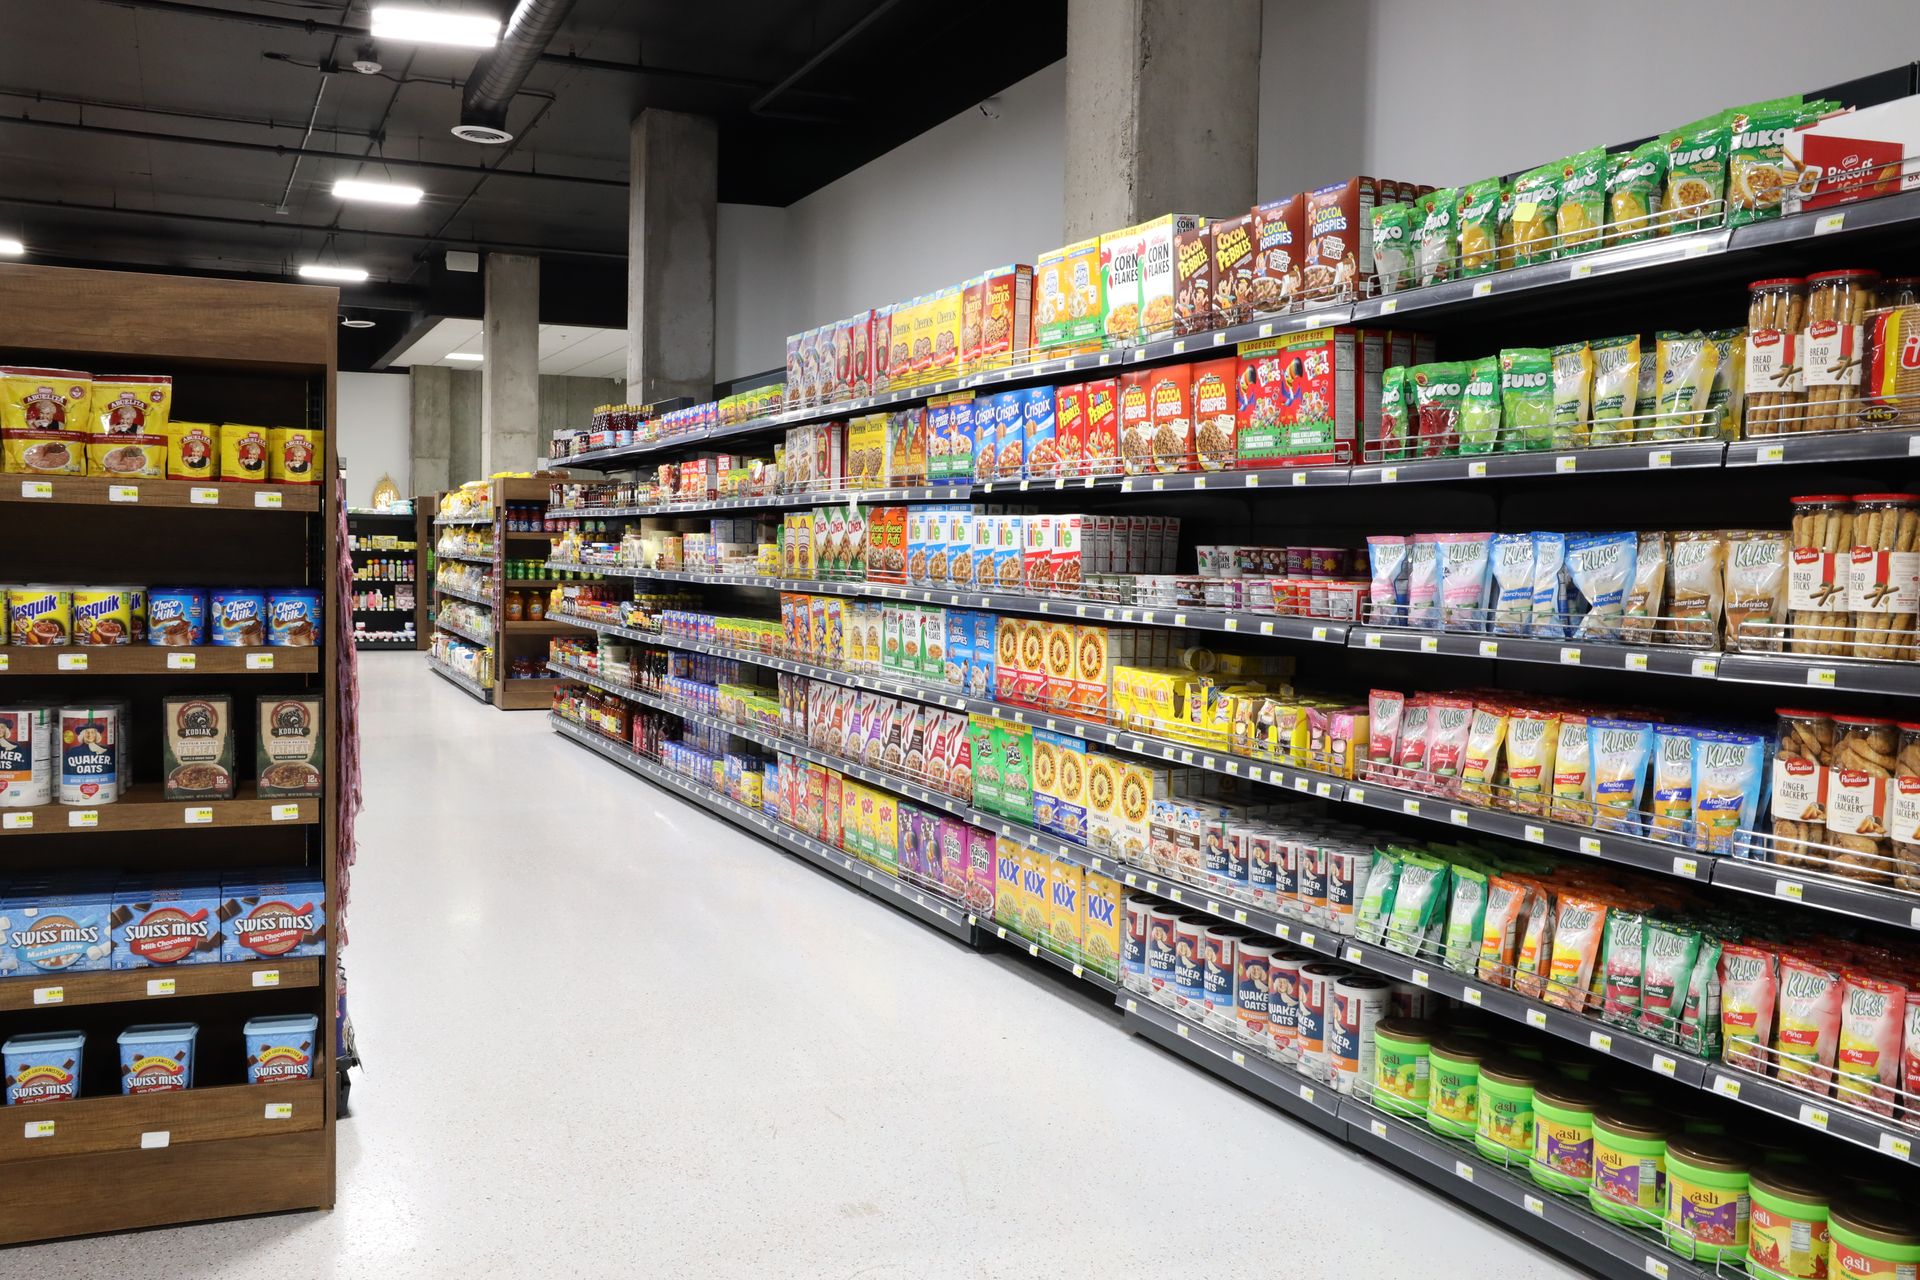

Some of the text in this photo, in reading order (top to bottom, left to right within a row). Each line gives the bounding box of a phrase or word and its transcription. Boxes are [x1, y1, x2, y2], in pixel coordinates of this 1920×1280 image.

[1828, 158, 1873, 184] Biscoff
[1316, 207, 1342, 223] COCOA
[1177, 220, 1195, 230] CORN
[1263, 222, 1288, 237] COCOA
[1312, 218, 1346, 237] KRISPIES
[1216, 226, 1246, 250] COCOA
[1260, 232, 1292, 251] KRISPIES
[1148, 243, 1169, 263] CORN
[1179, 238, 1202, 260] COCOA
[1216, 239, 1251, 272] PEBBLES
[1115, 253, 1138, 270] CORN
[1148, 260, 1170, 277] FLAKES
[1178, 248, 1208, 282] PEBBLES
[1115, 269, 1138, 285] FLAKES
[986, 290, 1010, 305] Cheerios
[1289, 331, 1324, 343] LARGE SIZE
[1811, 325, 1836, 335] Paradise
[1244, 340, 1276, 351] LARGE SIZE
[1754, 334, 1779, 344] Paradise
[1304, 350, 1328, 369] FROOT
[1810, 348, 1829, 356] BREAD
[1257, 359, 1279, 376] FROOT
[1600, 350, 1627, 374] KLASS
[1753, 356, 1771, 364] BREAD
[1810, 357, 1827, 366] STICKS
[1307, 363, 1330, 381] LOOPS
[1753, 364, 1770, 373] STICKS
[1502, 372, 1547, 388] ZUKO
[1157, 389, 1181, 403] COCOA
[1200, 383, 1226, 398] COCOA
[27, 394, 64, 404] ABUELITA
[110, 400, 145, 409] ABUELITA
[1125, 393, 1146, 407] COCOA
[975, 404, 995, 426] Crispix
[996, 401, 1020, 422] Crispix
[1025, 396, 1050, 419] Crispix
[1088, 400, 1113, 425] PEBBLES
[1058, 403, 1080, 429] PEBBLES
[182, 435, 211, 445] ABUELITA
[286, 440, 312, 448] ABUELITA
[830, 521, 844, 534] Chex
[1449, 543, 1482, 564] KLASS
[1582, 546, 1618, 571] KLASS
[1676, 544, 1708, 567] KLASS
[1736, 543, 1776, 567] KLASS
[1794, 552, 1817, 561] Paradise
[1793, 572, 1811, 582] BREAD
[1793, 582, 1810, 590] STICKS
[153, 600, 178, 611] Choco
[226, 600, 253, 612] Choco
[276, 601, 302, 612] Choco
[155, 609, 176, 620] Milk
[230, 609, 250, 621] Milk
[279, 610, 300, 621] Milk
[928, 621, 940, 631] CORN
[954, 626, 963, 635] RICE
[928, 631, 940, 640] FLAKES
[1439, 709, 1465, 728] KLASS
[186, 728, 211, 736] KODIAK
[278, 728, 303, 736] KODIAK
[1514, 721, 1545, 741] KLASS
[1061, 737, 1080, 748] LARGE SIZE
[1602, 731, 1638, 753] KLASS
[68, 755, 110, 766] QUAKER
[1006, 750, 1021, 762] JACKS
[1707, 745, 1745, 768] KLASS
[76, 765, 102, 774] OATS
[1786, 763, 1814, 772] Paradise
[1783, 781, 1804, 791] FINGER
[1841, 774, 1867, 784] Paradise
[1132, 777, 1146, 807] BUNCHES
[1780, 790, 1808, 801] CRACKERS
[1837, 794, 1860, 804] FINGER
[1097, 799, 1110, 809] OATS
[1834, 802, 1864, 813] CRACKERS
[1129, 810, 1143, 820] OATS
[944, 835, 960, 851] Raisin
[945, 847, 960, 862] Bran
[970, 845, 989, 860] Raisin
[972, 857, 987, 872] Bran
[998, 858, 1019, 886] KIX
[1024, 870, 1045, 898] KIX
[1053, 883, 1076, 912] KIX
[1088, 895, 1115, 927] KIX
[1561, 909, 1592, 928] KLASS
[125, 921, 208, 942] SWISS MISS
[234, 914, 314, 935] SWISS MISS
[11, 926, 98, 948] SWISS MISS
[141, 936, 191, 951] Milk Chocolate
[250, 929, 297, 943] Milk Chocolate
[27, 944, 83, 959] Marshmallow
[1653, 934, 1683, 956] KLASS
[1151, 960, 1167, 970] OATS
[1729, 958, 1762, 981] KLASS
[1787, 973, 1826, 998] KLASS
[1239, 990, 1268, 1001] QUAKE
[1850, 990, 1886, 1016] KLASS
[1245, 1000, 1267, 1011] OATS
[1272, 1015, 1293, 1025] OATS
[254, 1064, 308, 1078] SWISS MISS
[127, 1074, 183, 1088] SWISS MISS
[12, 1084, 72, 1099] SWISS MISS
[1694, 1207, 1715, 1216] Guava
